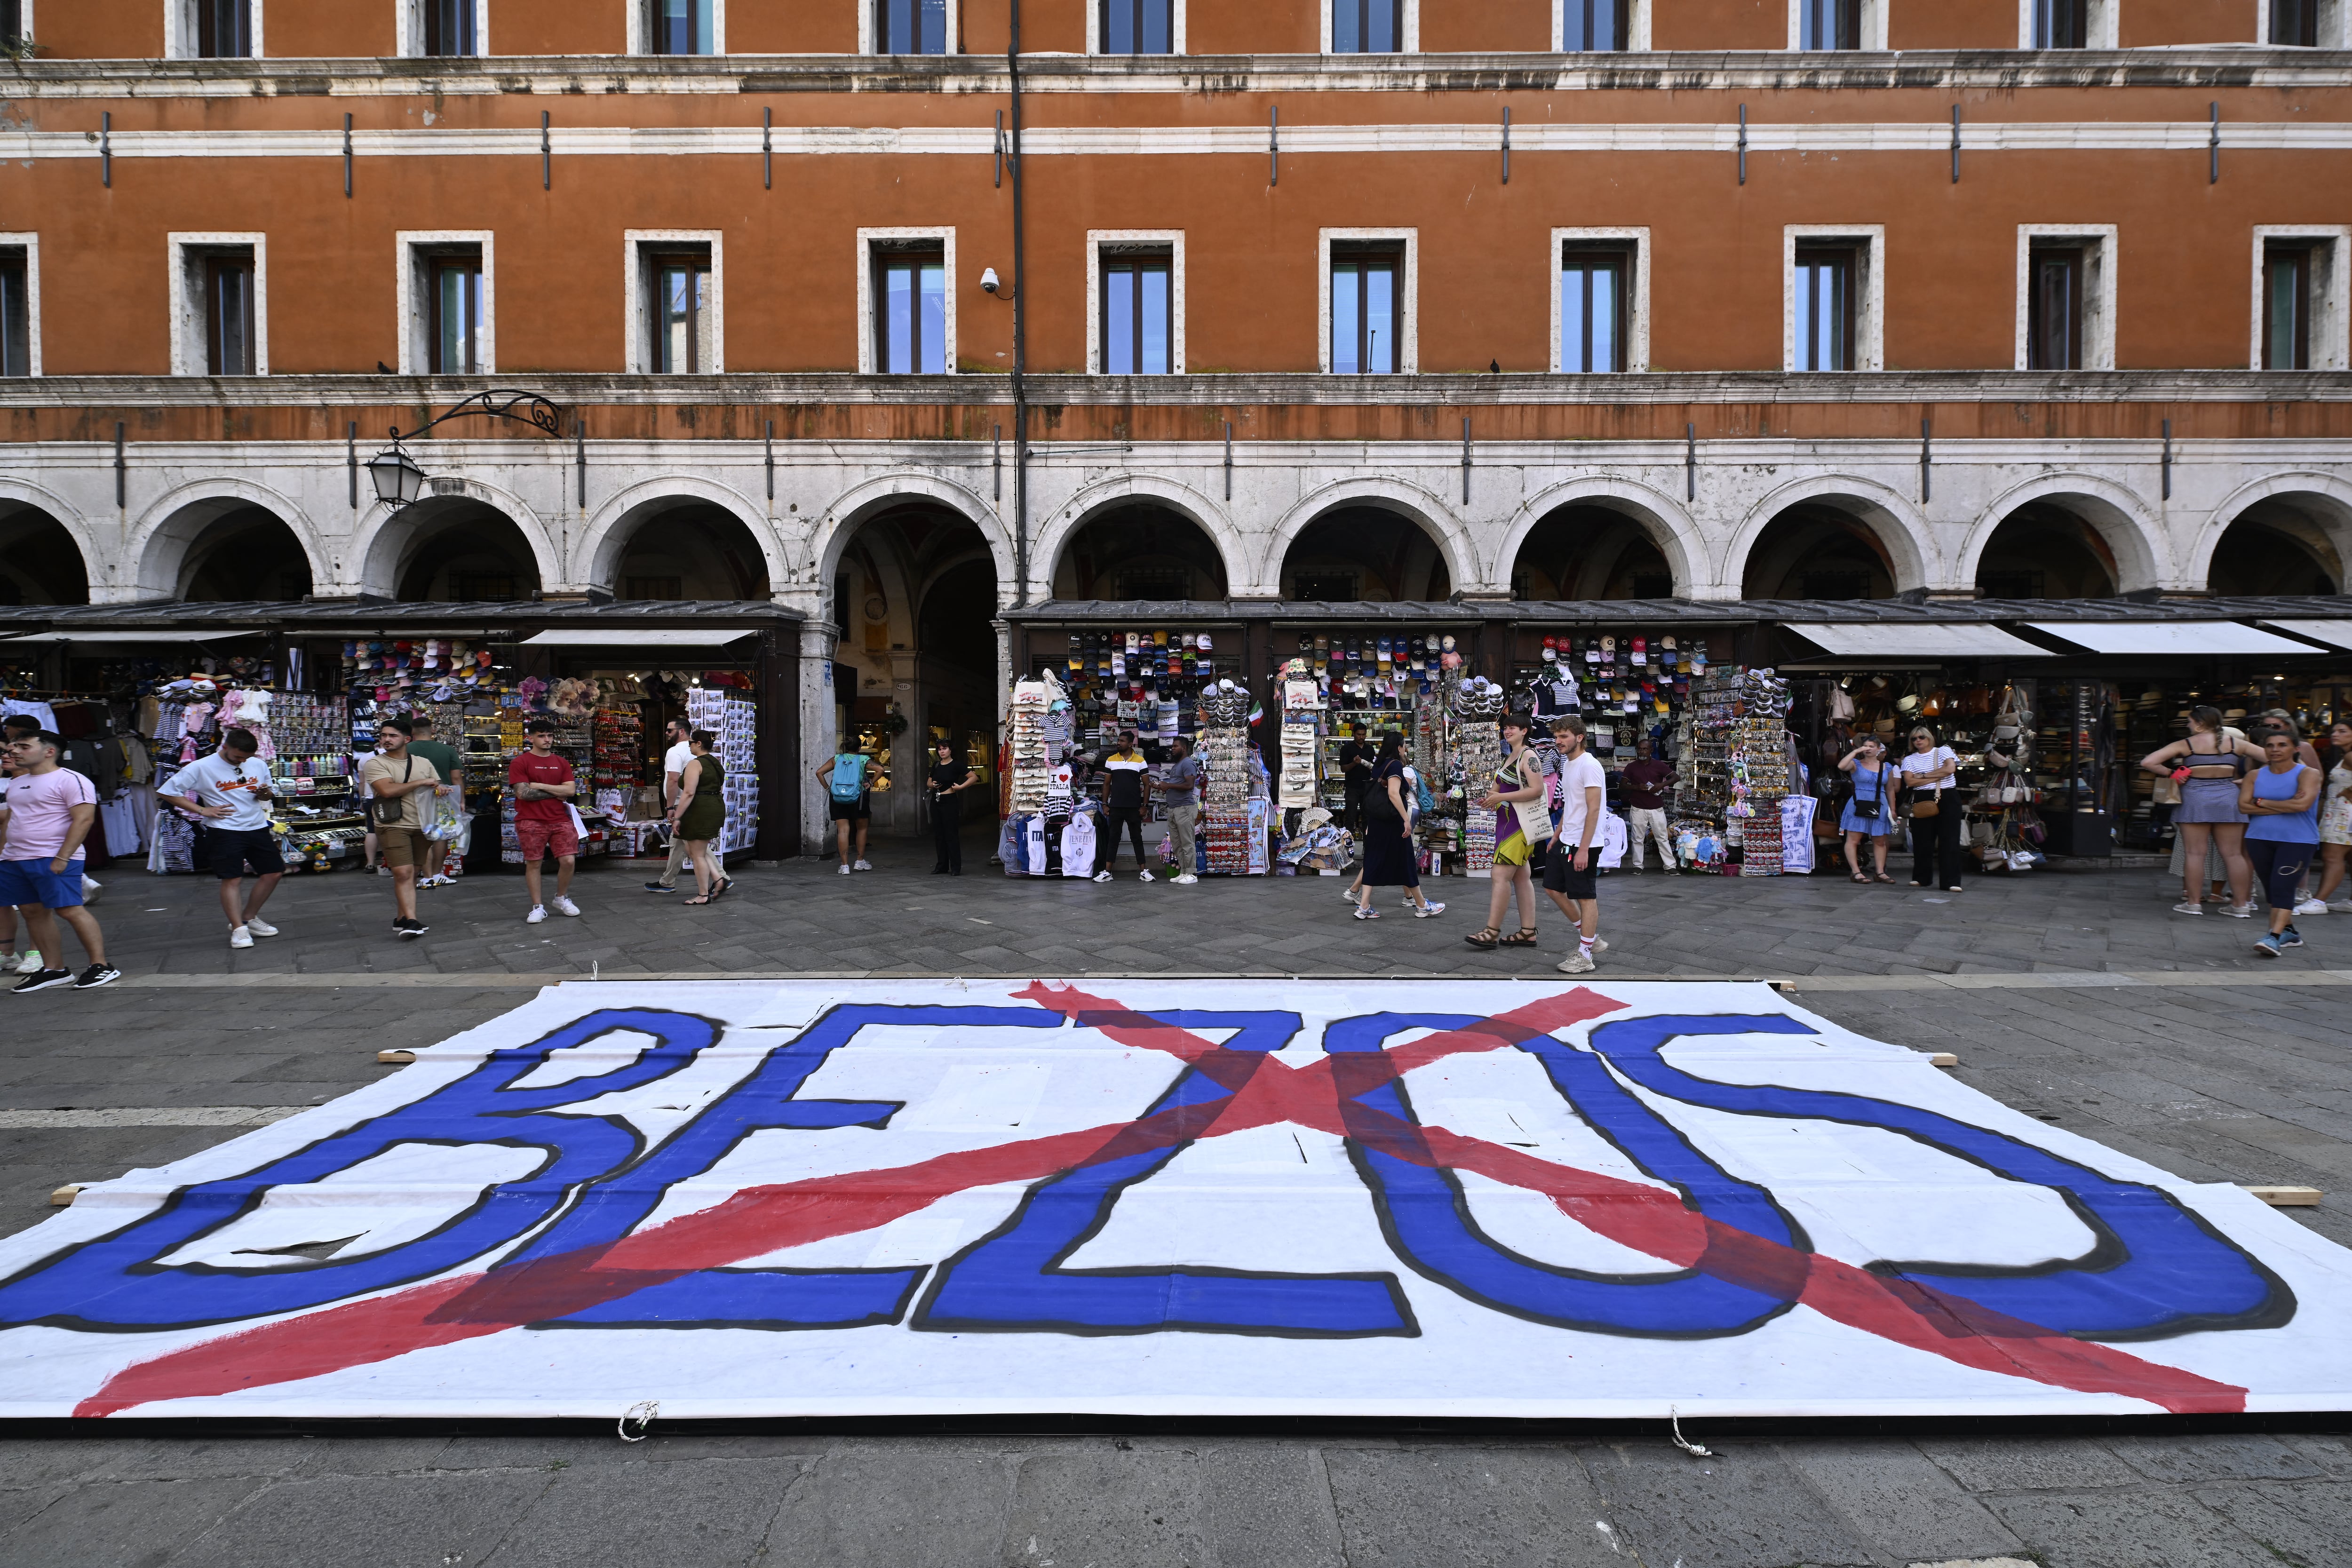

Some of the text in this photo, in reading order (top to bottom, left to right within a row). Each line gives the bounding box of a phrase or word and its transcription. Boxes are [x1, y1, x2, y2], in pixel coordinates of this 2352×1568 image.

[825, 672, 831, 681] WC
[1051, 774, 1057, 783] I
[1032, 830, 1043, 842] ITA
[0, 1005, 2297, 1338] BEZOS
